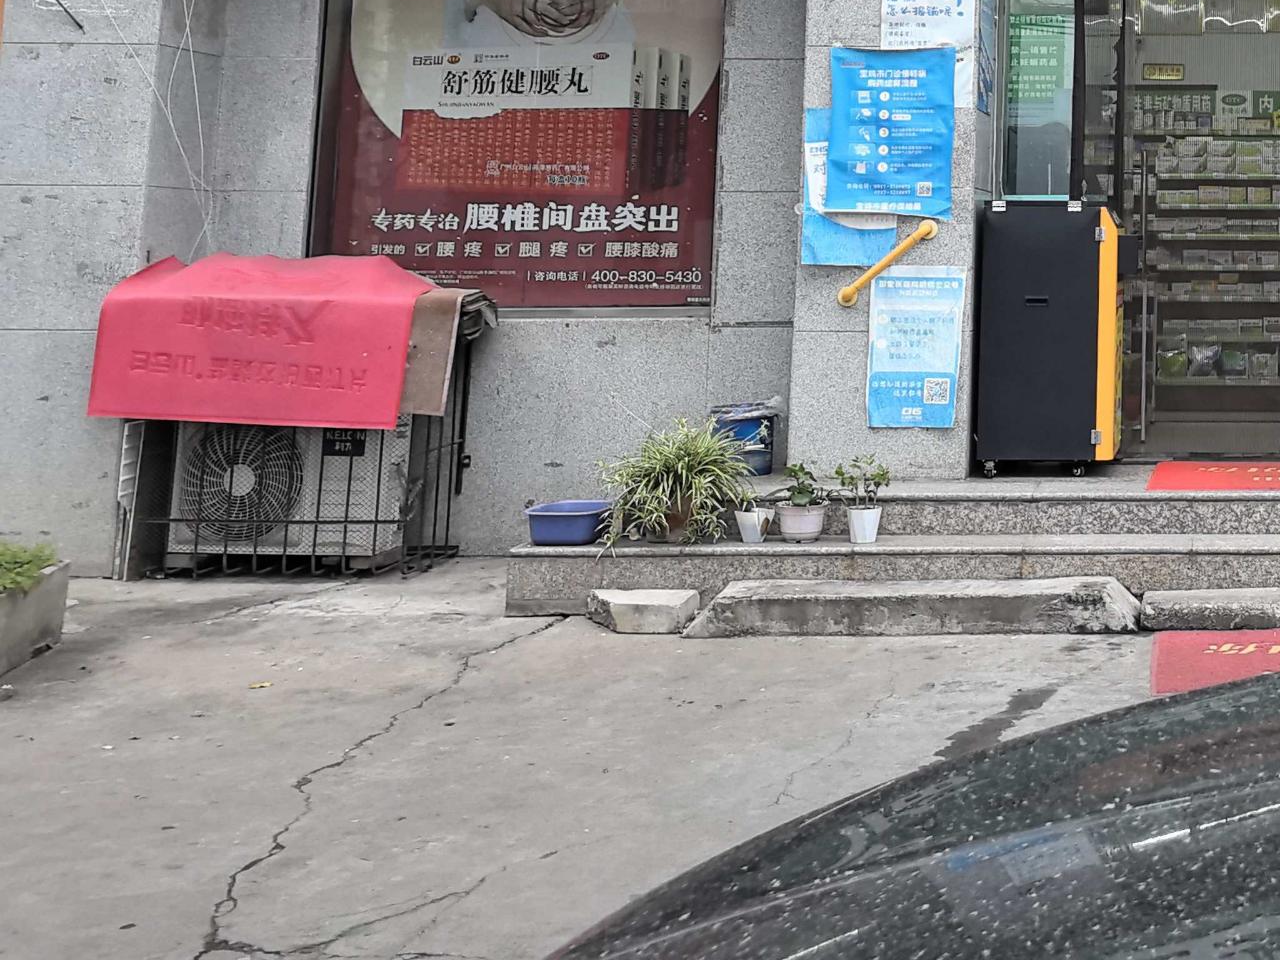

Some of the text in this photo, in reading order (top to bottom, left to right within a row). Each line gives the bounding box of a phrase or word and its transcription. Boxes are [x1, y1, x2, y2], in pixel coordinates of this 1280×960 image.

[412, 55, 443, 66] 白云山
[442, 67, 589, 96] 舒筋健腰丸
[371, 202, 678, 234] 专药专治 腰椎间盘突出
[370, 241, 679, 258] 引发的 腰疼 腿疼 腰膝酸痛
[534, 270, 702, 283] 咨询电话 400-830-5430
